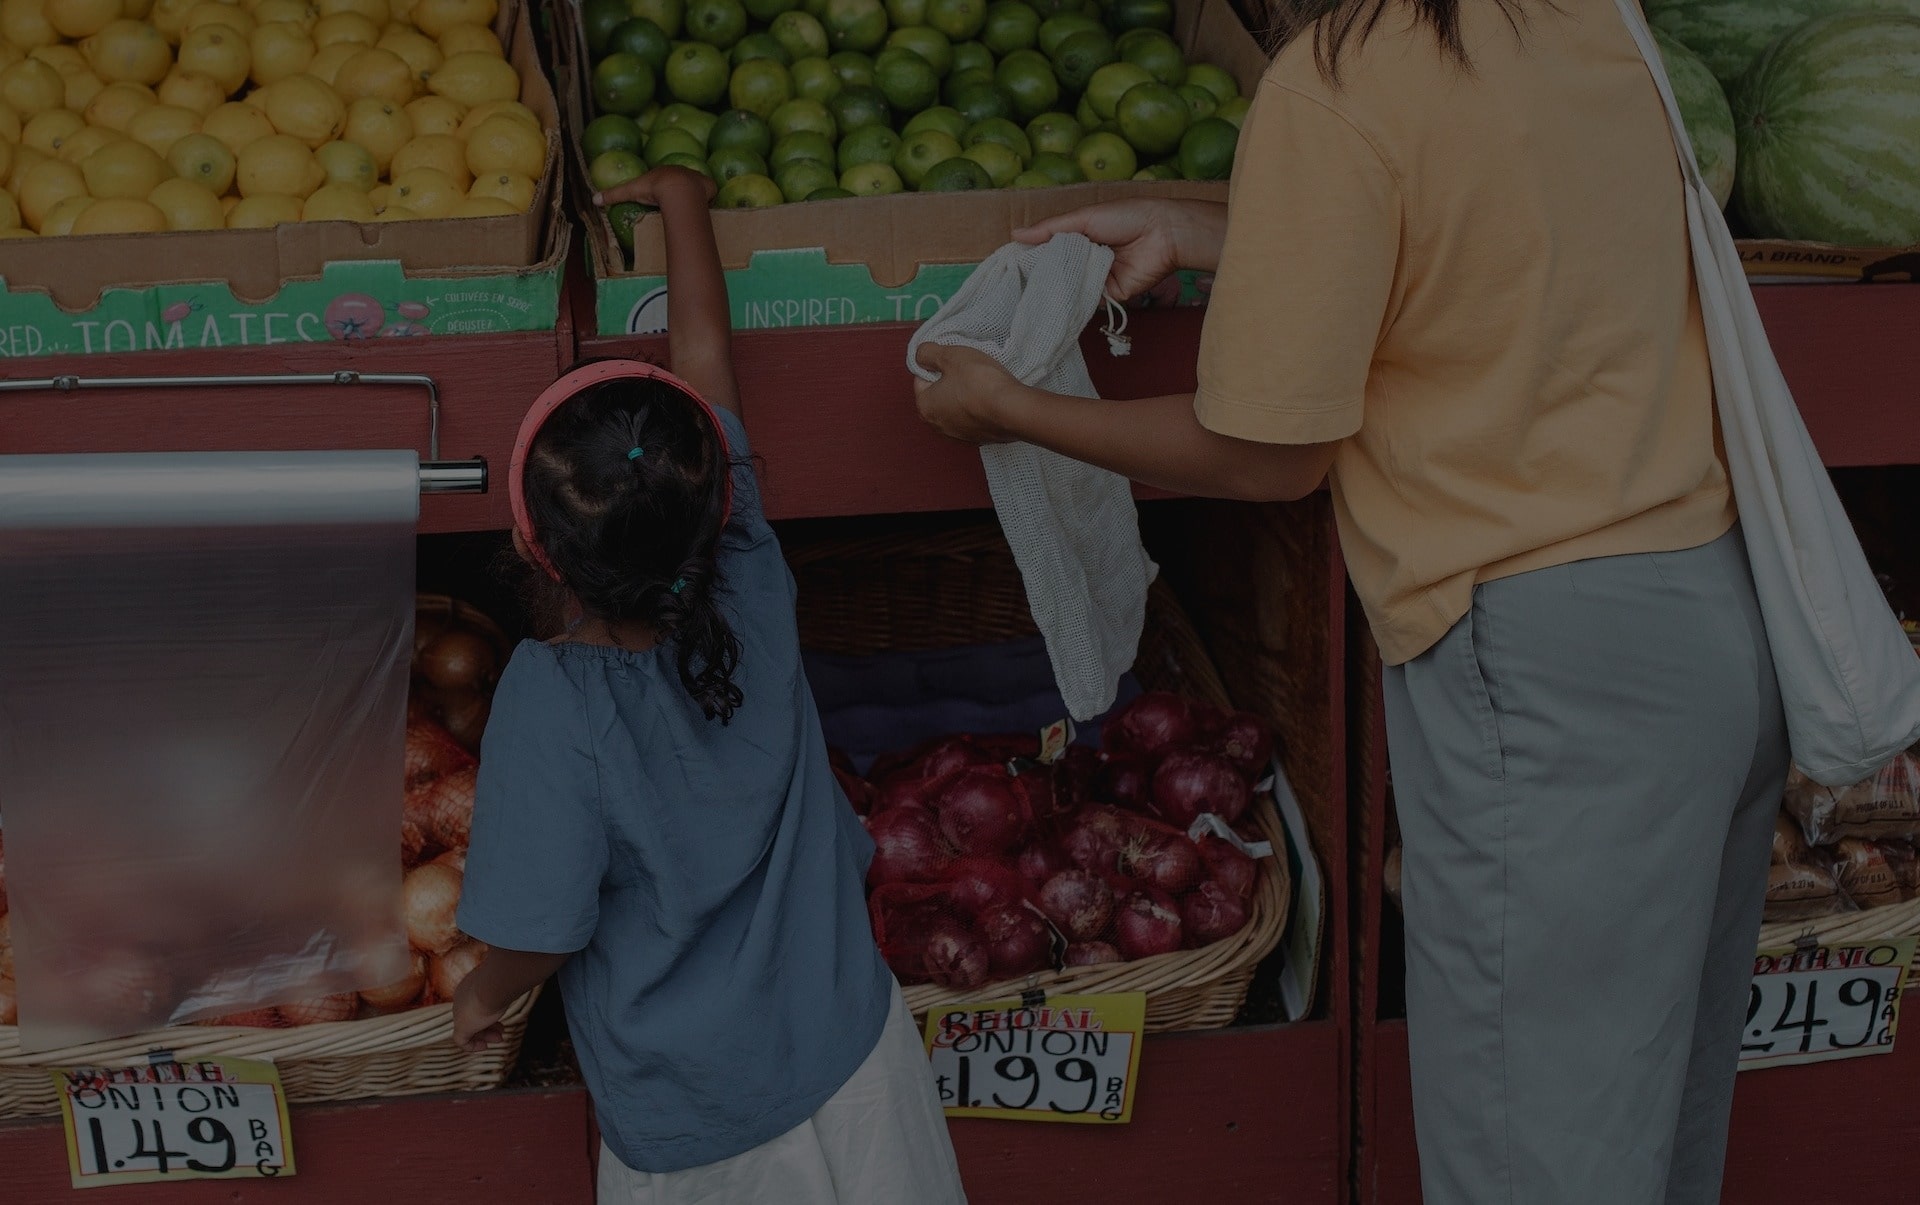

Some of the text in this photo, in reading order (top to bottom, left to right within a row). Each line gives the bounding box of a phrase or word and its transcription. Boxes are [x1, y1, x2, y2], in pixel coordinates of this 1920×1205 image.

[491, 293, 505, 304] EN
[744, 297, 856, 329] INSPIRED
[72, 312, 319, 354] TOMATES
[1877, 987, 1899, 1046] BAG
[952, 1030, 1109, 1056] ONION
[74, 1084, 240, 1113] ONION
[1100, 1077, 1123, 1121] BAG
[88, 1117, 237, 1174] 1.49
[248, 1118, 281, 1177] BAG
